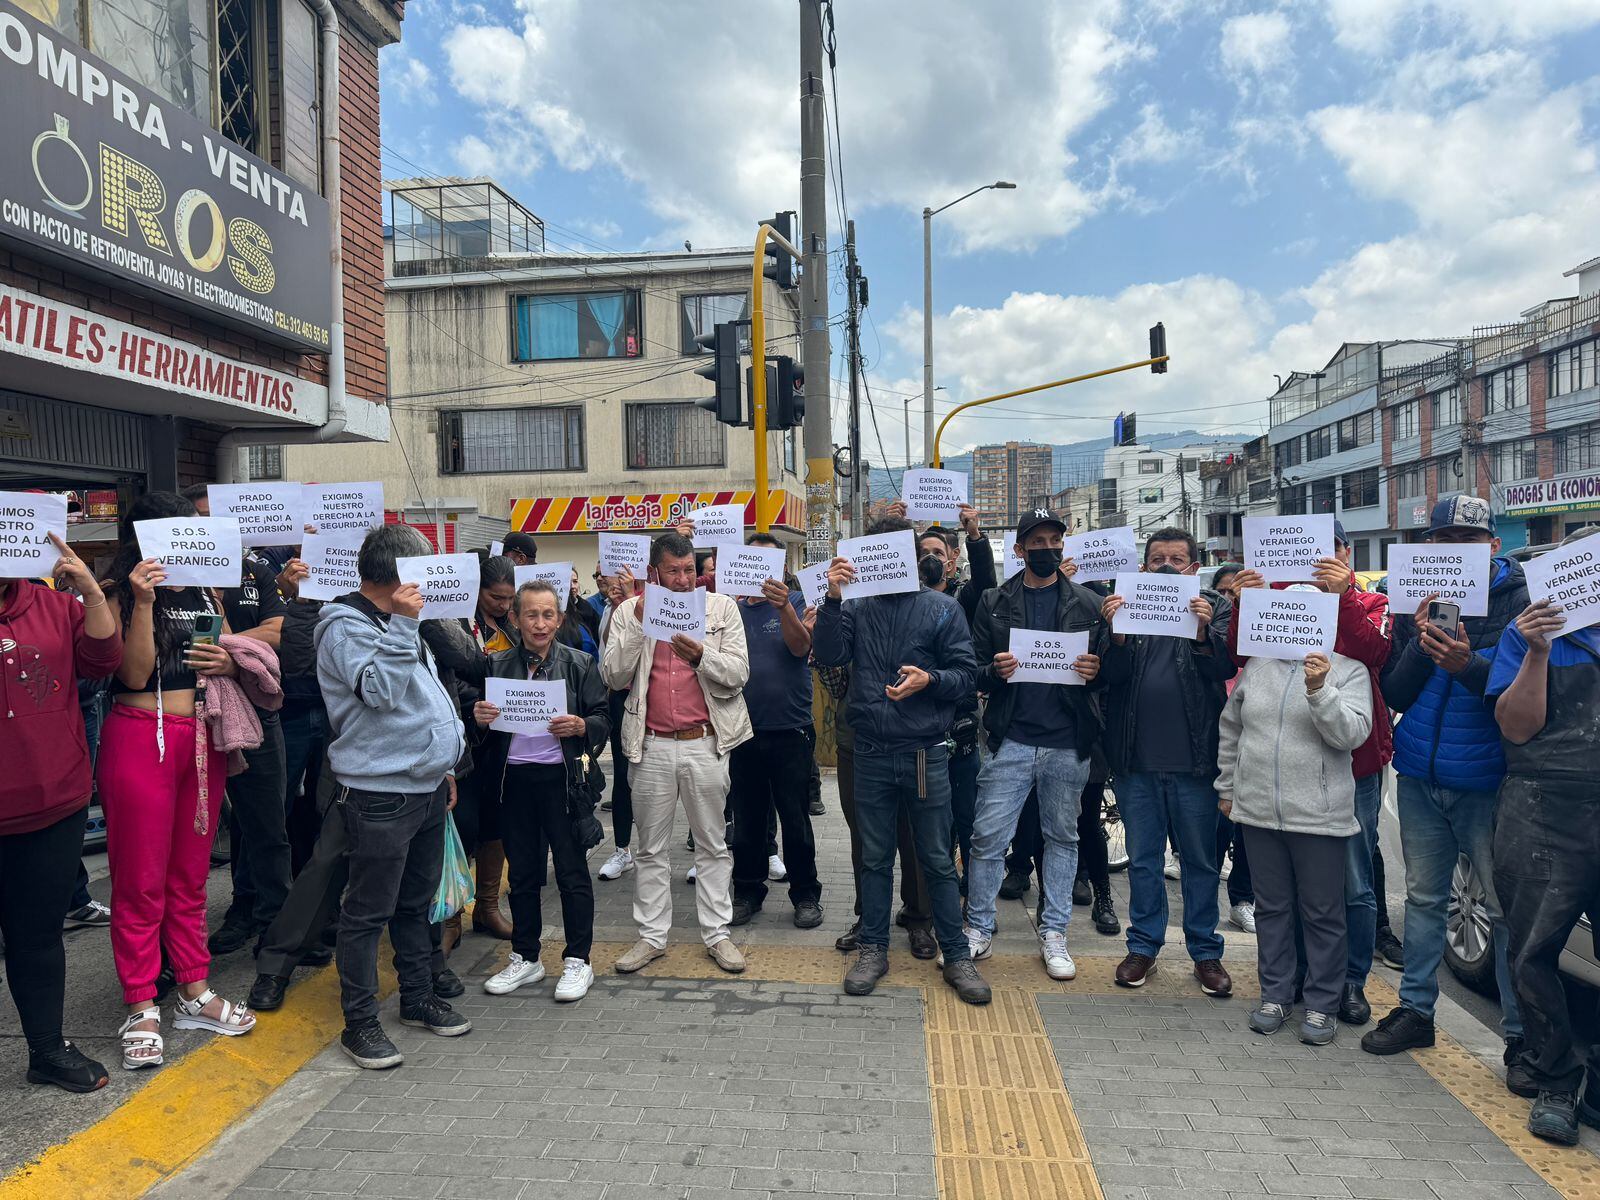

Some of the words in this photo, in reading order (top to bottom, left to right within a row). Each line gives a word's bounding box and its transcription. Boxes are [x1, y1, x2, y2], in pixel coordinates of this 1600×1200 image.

[203, 135, 308, 227] VENTA
[2, 199, 30, 230] CON
[33, 211, 70, 245] PACTO
[73, 228, 88, 253] DE
[90, 234, 155, 280] RETROVENTA
[157, 263, 184, 292] JOYAS
[186, 274, 193, 293] Y
[194, 277, 274, 325] ELECTRODOMESTICOS
[289, 315, 300, 335] 312
[239, 494, 273, 502] PRADO
[322, 493, 364, 501] EXIGIMOS
[1507, 484, 1543, 506] DROGAS
[1547, 482, 1557, 501] LA
[229, 503, 285, 514] VERANIEGO
[323, 502, 364, 511] NUESTRO
[239, 516, 260, 524] DICE
[263, 515, 283, 524] ¡NO!
[313, 512, 354, 521] DERECHO
[240, 523, 293, 534] EXTORSIÓN
[320, 520, 370, 530] SEGURIDAD
[171, 527, 210, 536] S.O.S.
[693, 528, 736, 536] VERANIEGO
[1269, 527, 1304, 535] PRADO
[22, 536, 31, 544] A
[35, 537, 51, 545] LA
[1084, 538, 1111, 548] S.O.S.
[1260, 536, 1315, 546] VERANIEGO
[171, 541, 216, 551] PRADO
[861, 543, 889, 553] PRADO
[604, 554, 630, 562] DERECHO
[738, 554, 763, 562] PRADO
[852, 552, 900, 564] VERANIEGO
[1082, 549, 1116, 560] PRADO
[1254, 550, 1265, 558] LE
[1268, 549, 1290, 557] DICE
[1293, 548, 1312, 558] ¡NO!
[158, 555, 230, 567] VERANIEGO
[1254, 560, 1266, 568] LA
[1412, 556, 1462, 564] EXIGIMOS
[1553, 552, 1593, 572] PRADO
[426, 565, 457, 575] S.O.S.
[729, 562, 770, 571] VERANIEGO
[860, 564, 879, 574] DICE
[881, 562, 898, 573] ¡NO!
[1412, 567, 1461, 575] NUESTRO
[311, 567, 356, 577] DERECHO
[535, 571, 556, 579] PRADO
[849, 577, 860, 585] LA
[861, 570, 908, 583] EXTORSIÓN
[427, 579, 461, 590] PRADO
[1136, 583, 1180, 593] EXIGIMOS
[1399, 579, 1447, 587] DERECHO
[1557, 584, 1588, 601] DICE
[1135, 593, 1178, 603] NUESTRO
[1123, 602, 1167, 612] DERECHO
[1168, 605, 1176, 613] A
[1177, 606, 1189, 614] LA
[1271, 602, 1307, 611] PRADO
[659, 608, 691, 620] PRADO
[1129, 612, 1181, 623] SEGURIDAD
[1258, 611, 1318, 623] VERANIEGO
[649, 616, 700, 631] VERANIEGO
[1251, 623, 1263, 632] LE
[1266, 624, 1289, 633] DICE
[1292, 626, 1313, 635] ¡NO!
[1315, 628, 1324, 636] A
[1034, 640, 1064, 649] S.O.S.
[1249, 634, 1263, 642] LA
[1265, 634, 1323, 647] EXTORSIÓN
[1030, 652, 1066, 660] PRADO
[1018, 662, 1076, 671] VERANIEGO
[505, 690, 546, 698] EXIGIMOS
[503, 714, 552, 722] SEGURIDAD
